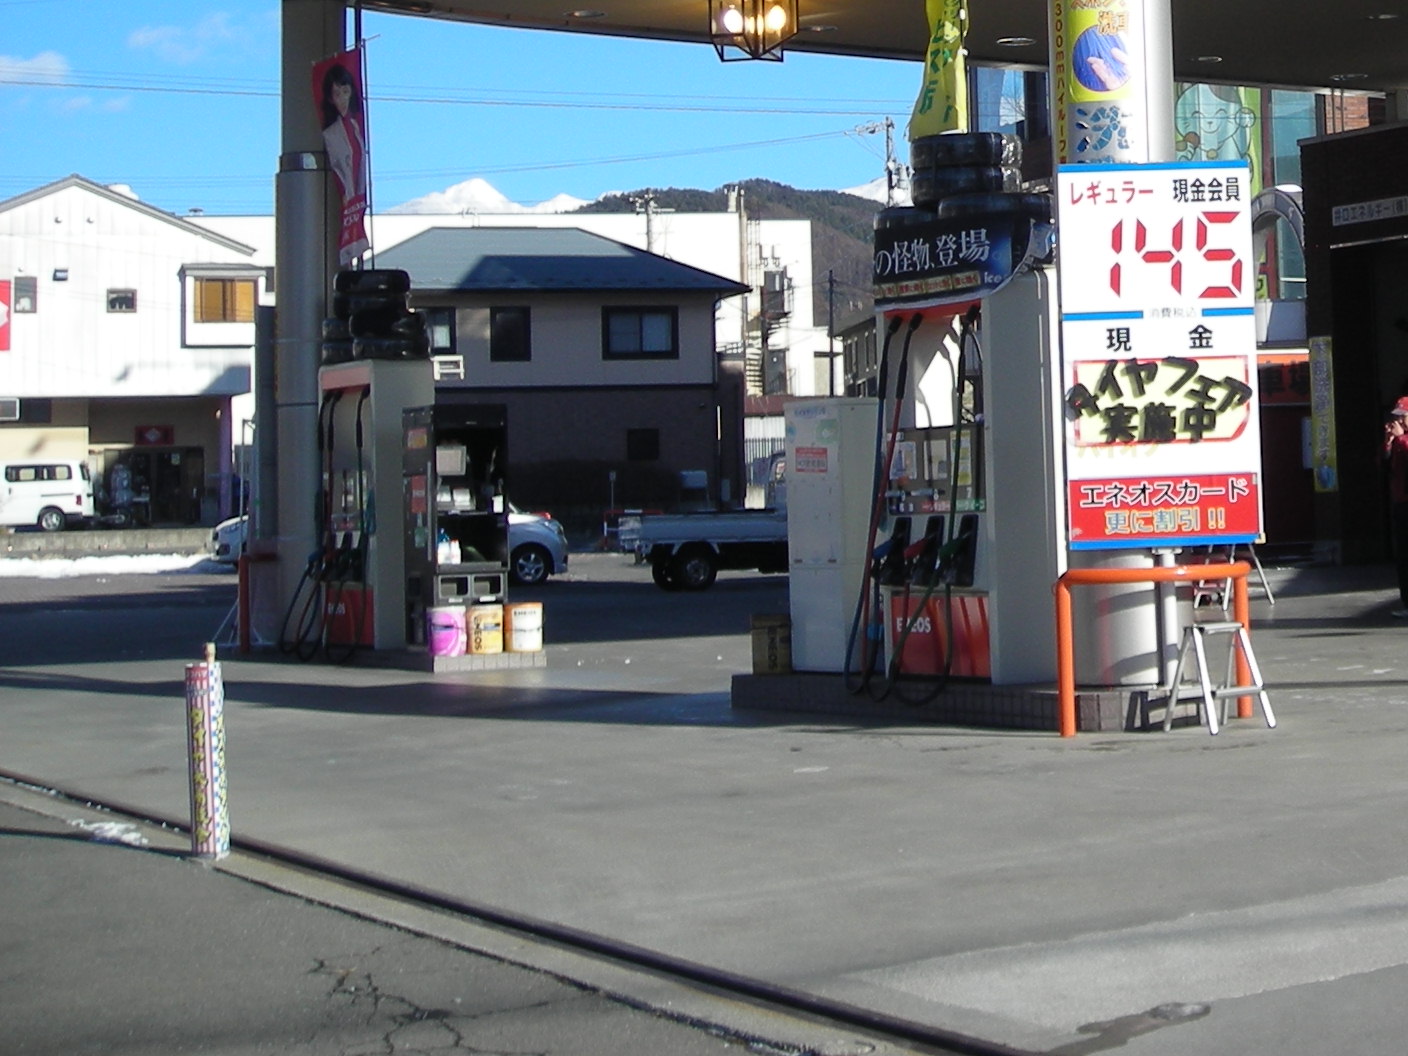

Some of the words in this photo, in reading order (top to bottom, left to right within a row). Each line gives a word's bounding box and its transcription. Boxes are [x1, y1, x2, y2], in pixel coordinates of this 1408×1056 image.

[1070, 181, 1154, 206] レギュラー
[1173, 177, 1241, 203] 現金会員
[1109, 211, 1242, 298] 145
[1100, 403, 1216, 444] 実施中
[1080, 479, 1248, 508] エネオスカード
[896, 617, 931, 633] EEOS
